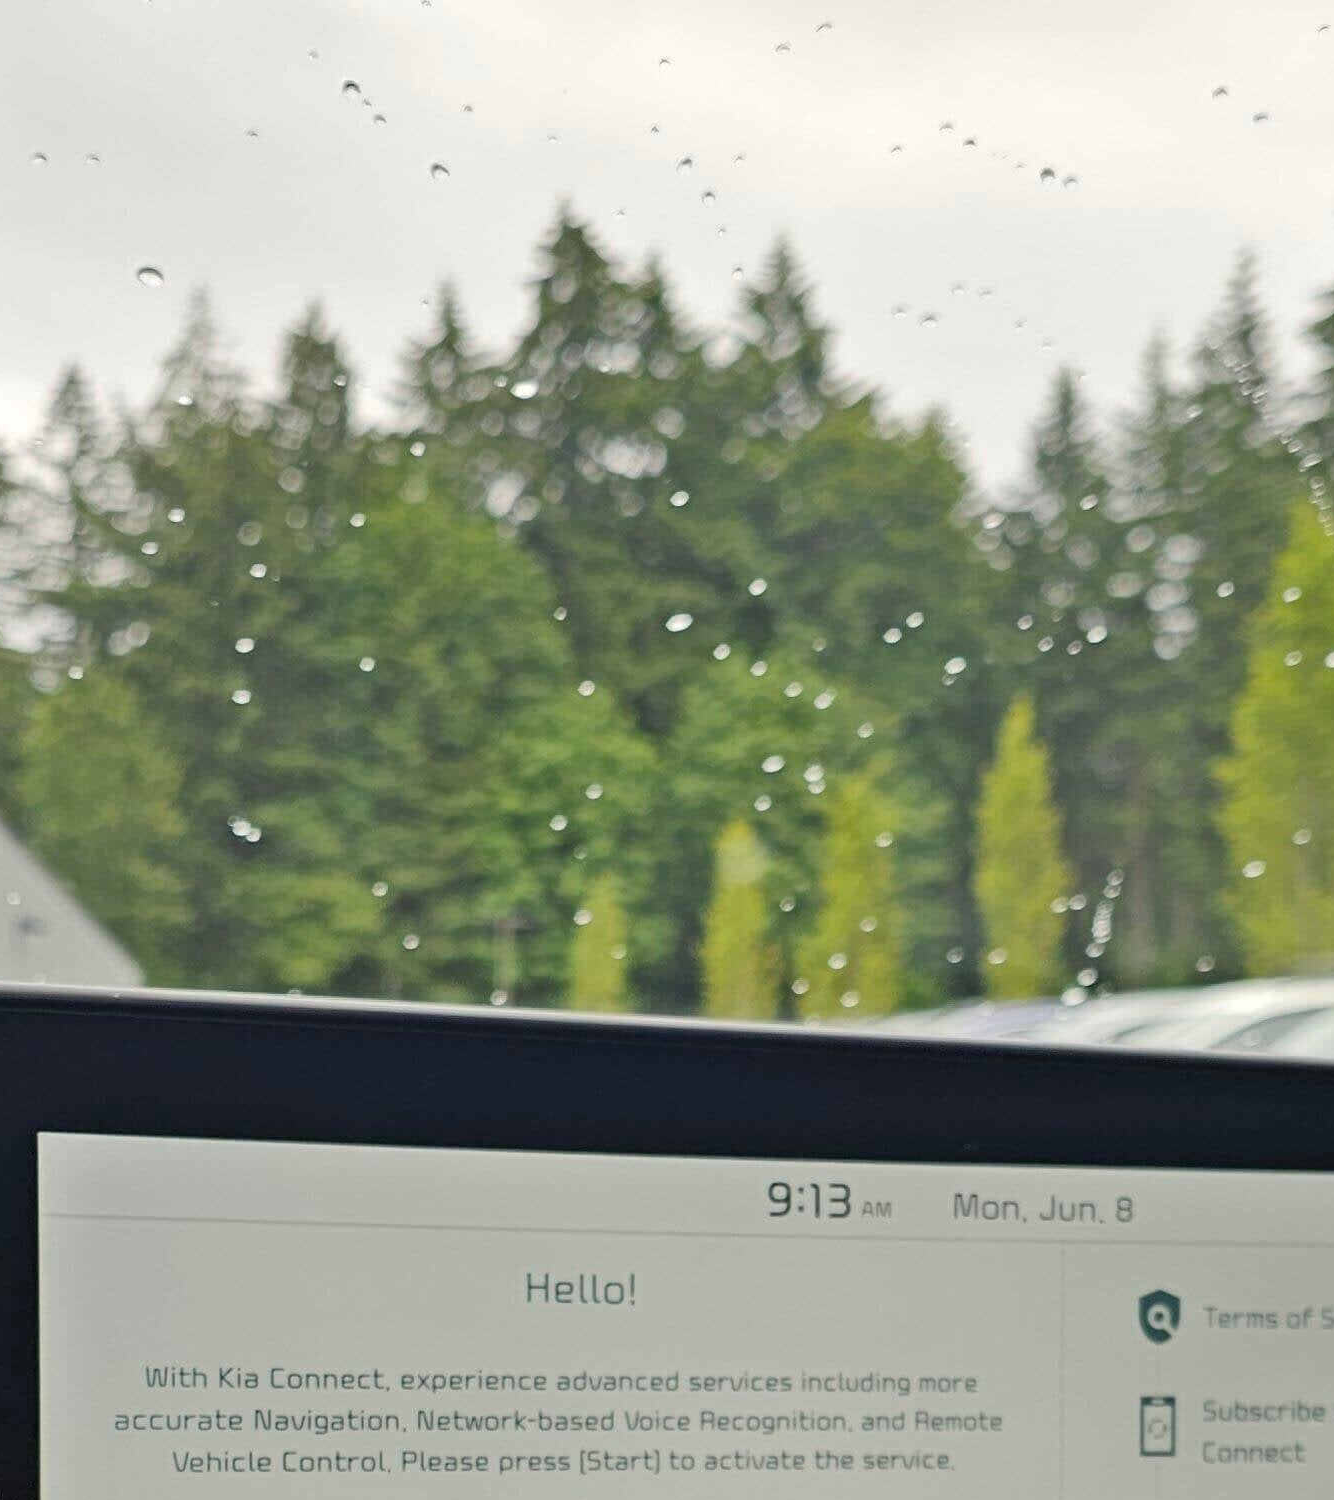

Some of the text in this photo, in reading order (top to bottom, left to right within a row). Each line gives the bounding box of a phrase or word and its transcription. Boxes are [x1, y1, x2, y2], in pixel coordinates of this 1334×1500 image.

[768, 1182, 892, 1218] 9:13 AM
[1115, 1196, 1133, 1222] 8
[527, 1272, 635, 1305] Hello!
[1203, 1306, 1278, 1329] Terms
[1286, 1307, 1313, 1329] of
[146, 1366, 977, 1396] With Kia Connect, experience advanced services including more
[115, 1410, 242, 1431] accurate
[255, 1409, 406, 1435] Navigation,
[418, 1410, 614, 1431] Network-based
[624, 1411, 690, 1431] Voice
[862, 1412, 905, 1431] and
[915, 1410, 1002, 1432] Remote
[1203, 1400, 1326, 1422] Subscribe
[173, 1451, 271, 1473] Vehicle
[402, 1451, 488, 1472] Please
[499, 1456, 570, 1475] press
[669, 1451, 695, 1470] to
[705, 1450, 805, 1470] activate
[814, 1450, 854, 1470] the
[863, 1451, 955, 1470] service.
[1203, 1441, 1304, 1464] Connect
